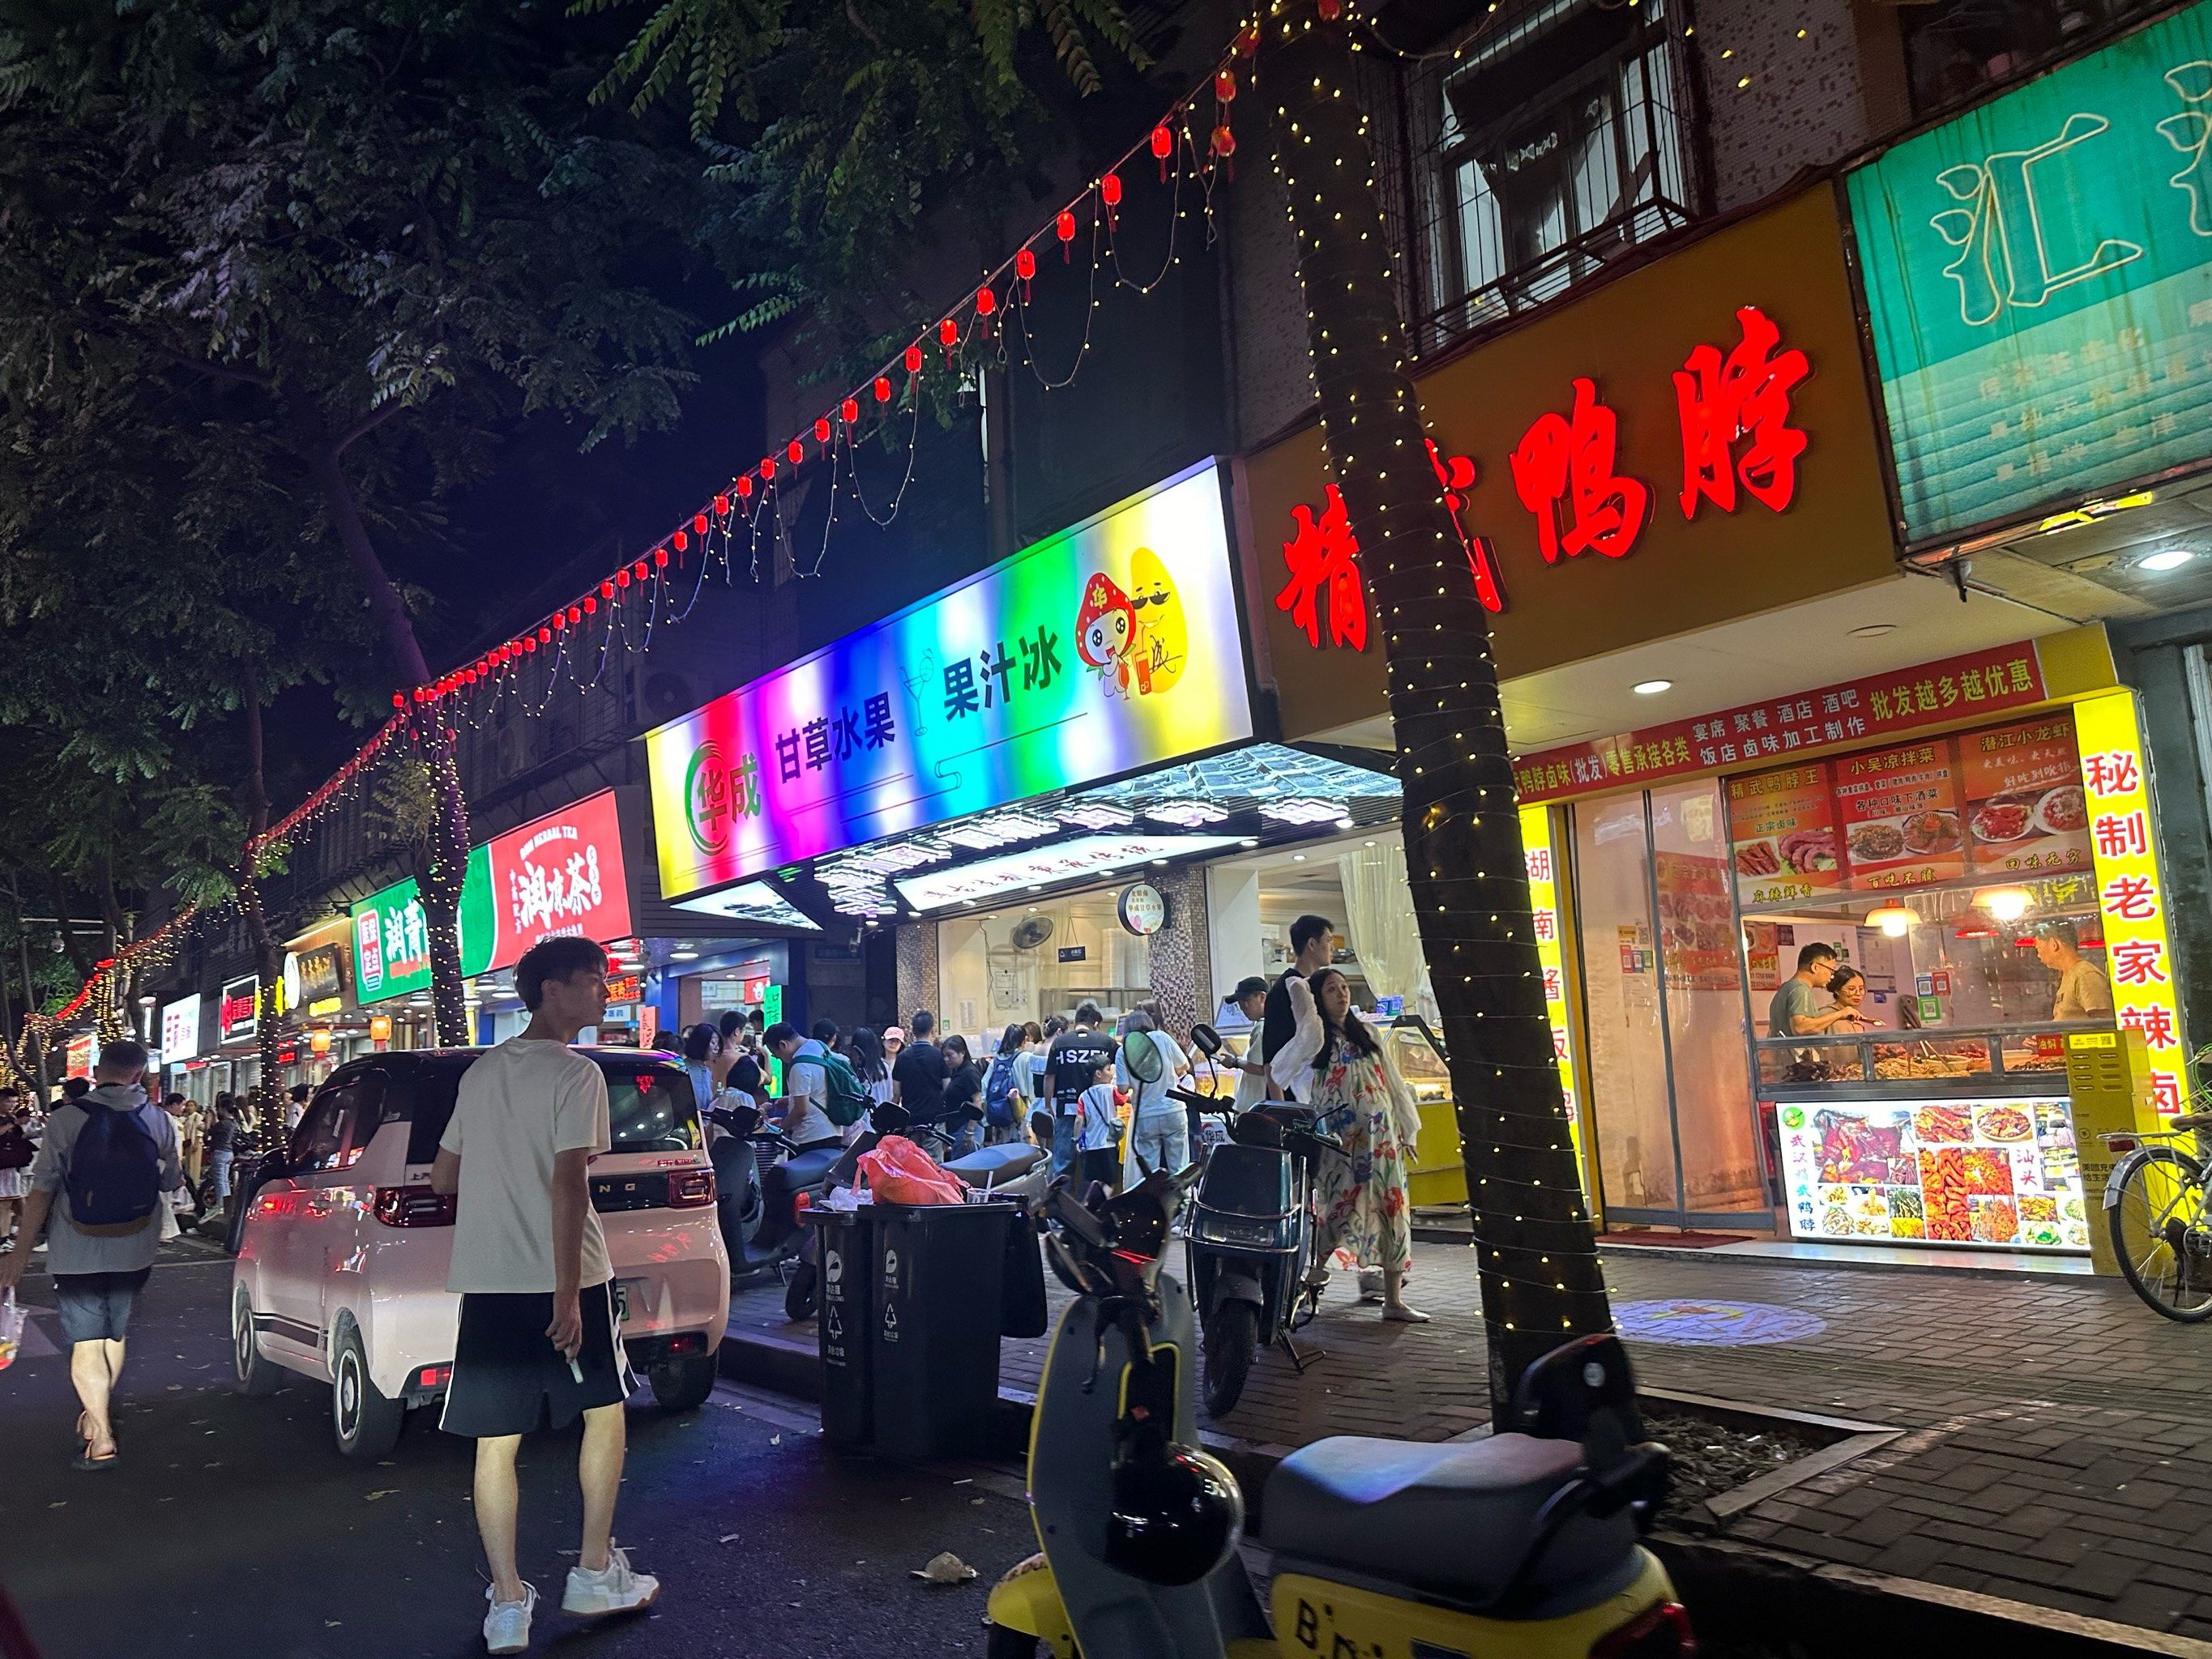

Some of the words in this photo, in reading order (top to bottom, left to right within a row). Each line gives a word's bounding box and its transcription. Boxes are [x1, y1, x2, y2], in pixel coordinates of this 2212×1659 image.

[942, 624, 1063, 723] 果汁冰
[1869, 658, 2034, 722] 批发越多越优惠
[1692, 719, 1726, 743] 宴席
[1733, 708, 1768, 732] 聚餐
[1776, 698, 1813, 723] 酒店
[1821, 688, 1860, 714] 酒吧
[775, 691, 896, 784] 甘草水果
[1980, 722, 2070, 752] 潜江小龙虾
[1851, 747, 1935, 775] 小吴凉拌菜
[694, 753, 762, 834] 华成
[1730, 768, 1819, 800] 精武鸭脖王
[1856, 787, 1939, 812] 各种口味下酒菜
[562, 825, 579, 840] TEA
[1755, 817, 1797, 834] 正宗卤味
[2005, 847, 2082, 870] 回味无穷
[1752, 883, 1813, 904] 麻辣鲜香
[1868, 867, 1937, 889] 百吃不腻
[2085, 752, 2181, 1116] 秘制老家辣卤
[1789, 1134, 1816, 1232] 武汉精武鸭脖
[2016, 1149, 2038, 1187] 汕头
